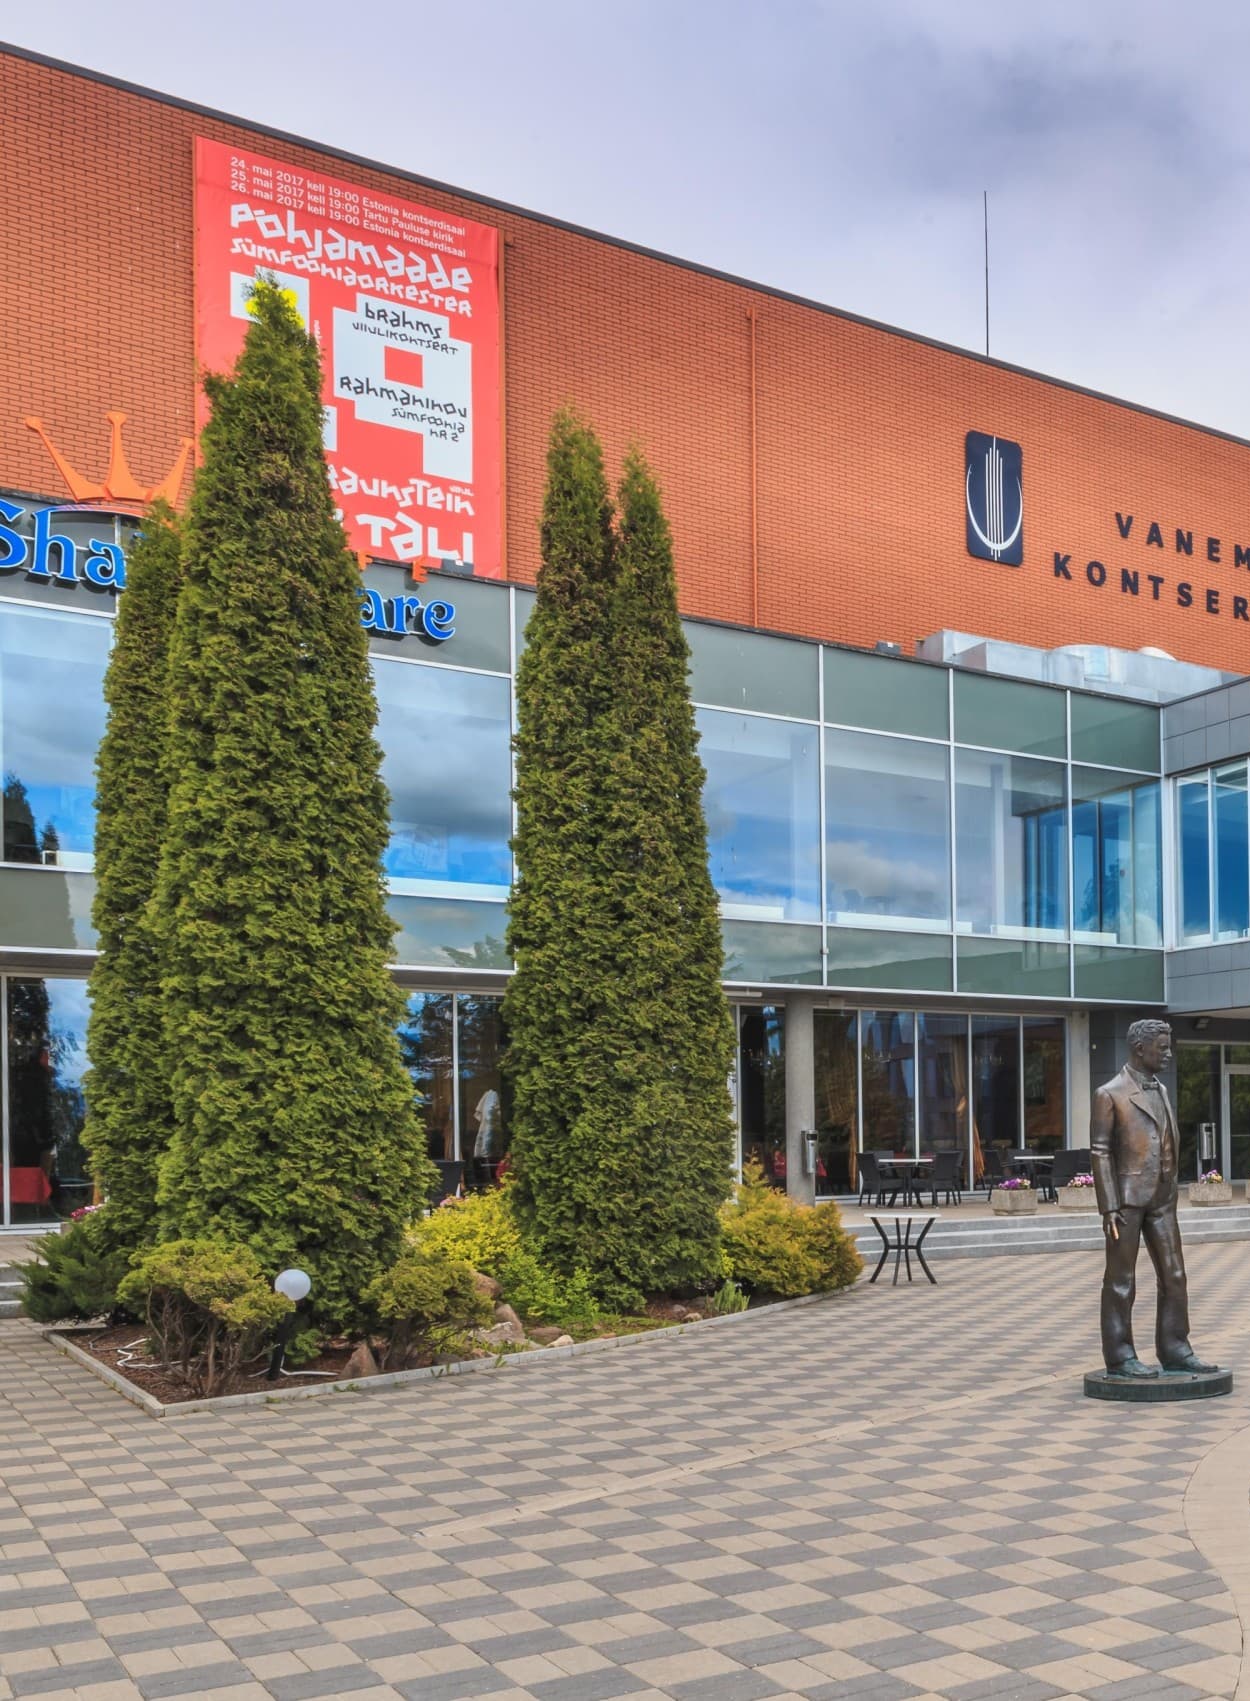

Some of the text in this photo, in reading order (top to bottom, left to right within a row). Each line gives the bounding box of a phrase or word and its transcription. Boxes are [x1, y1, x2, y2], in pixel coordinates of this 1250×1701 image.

[230, 156, 465, 236] 24. mai 2017 kell 19:00 Estonia kontserdisaal
[230, 168, 453, 243] 25. mai 2017 kell 19:00 Tartu Pauluse kirik
[230, 180, 466, 258] 26. mai 2017 kell 19:00 Estonia kontserdisaal
[451, 432, 459, 442] 2
